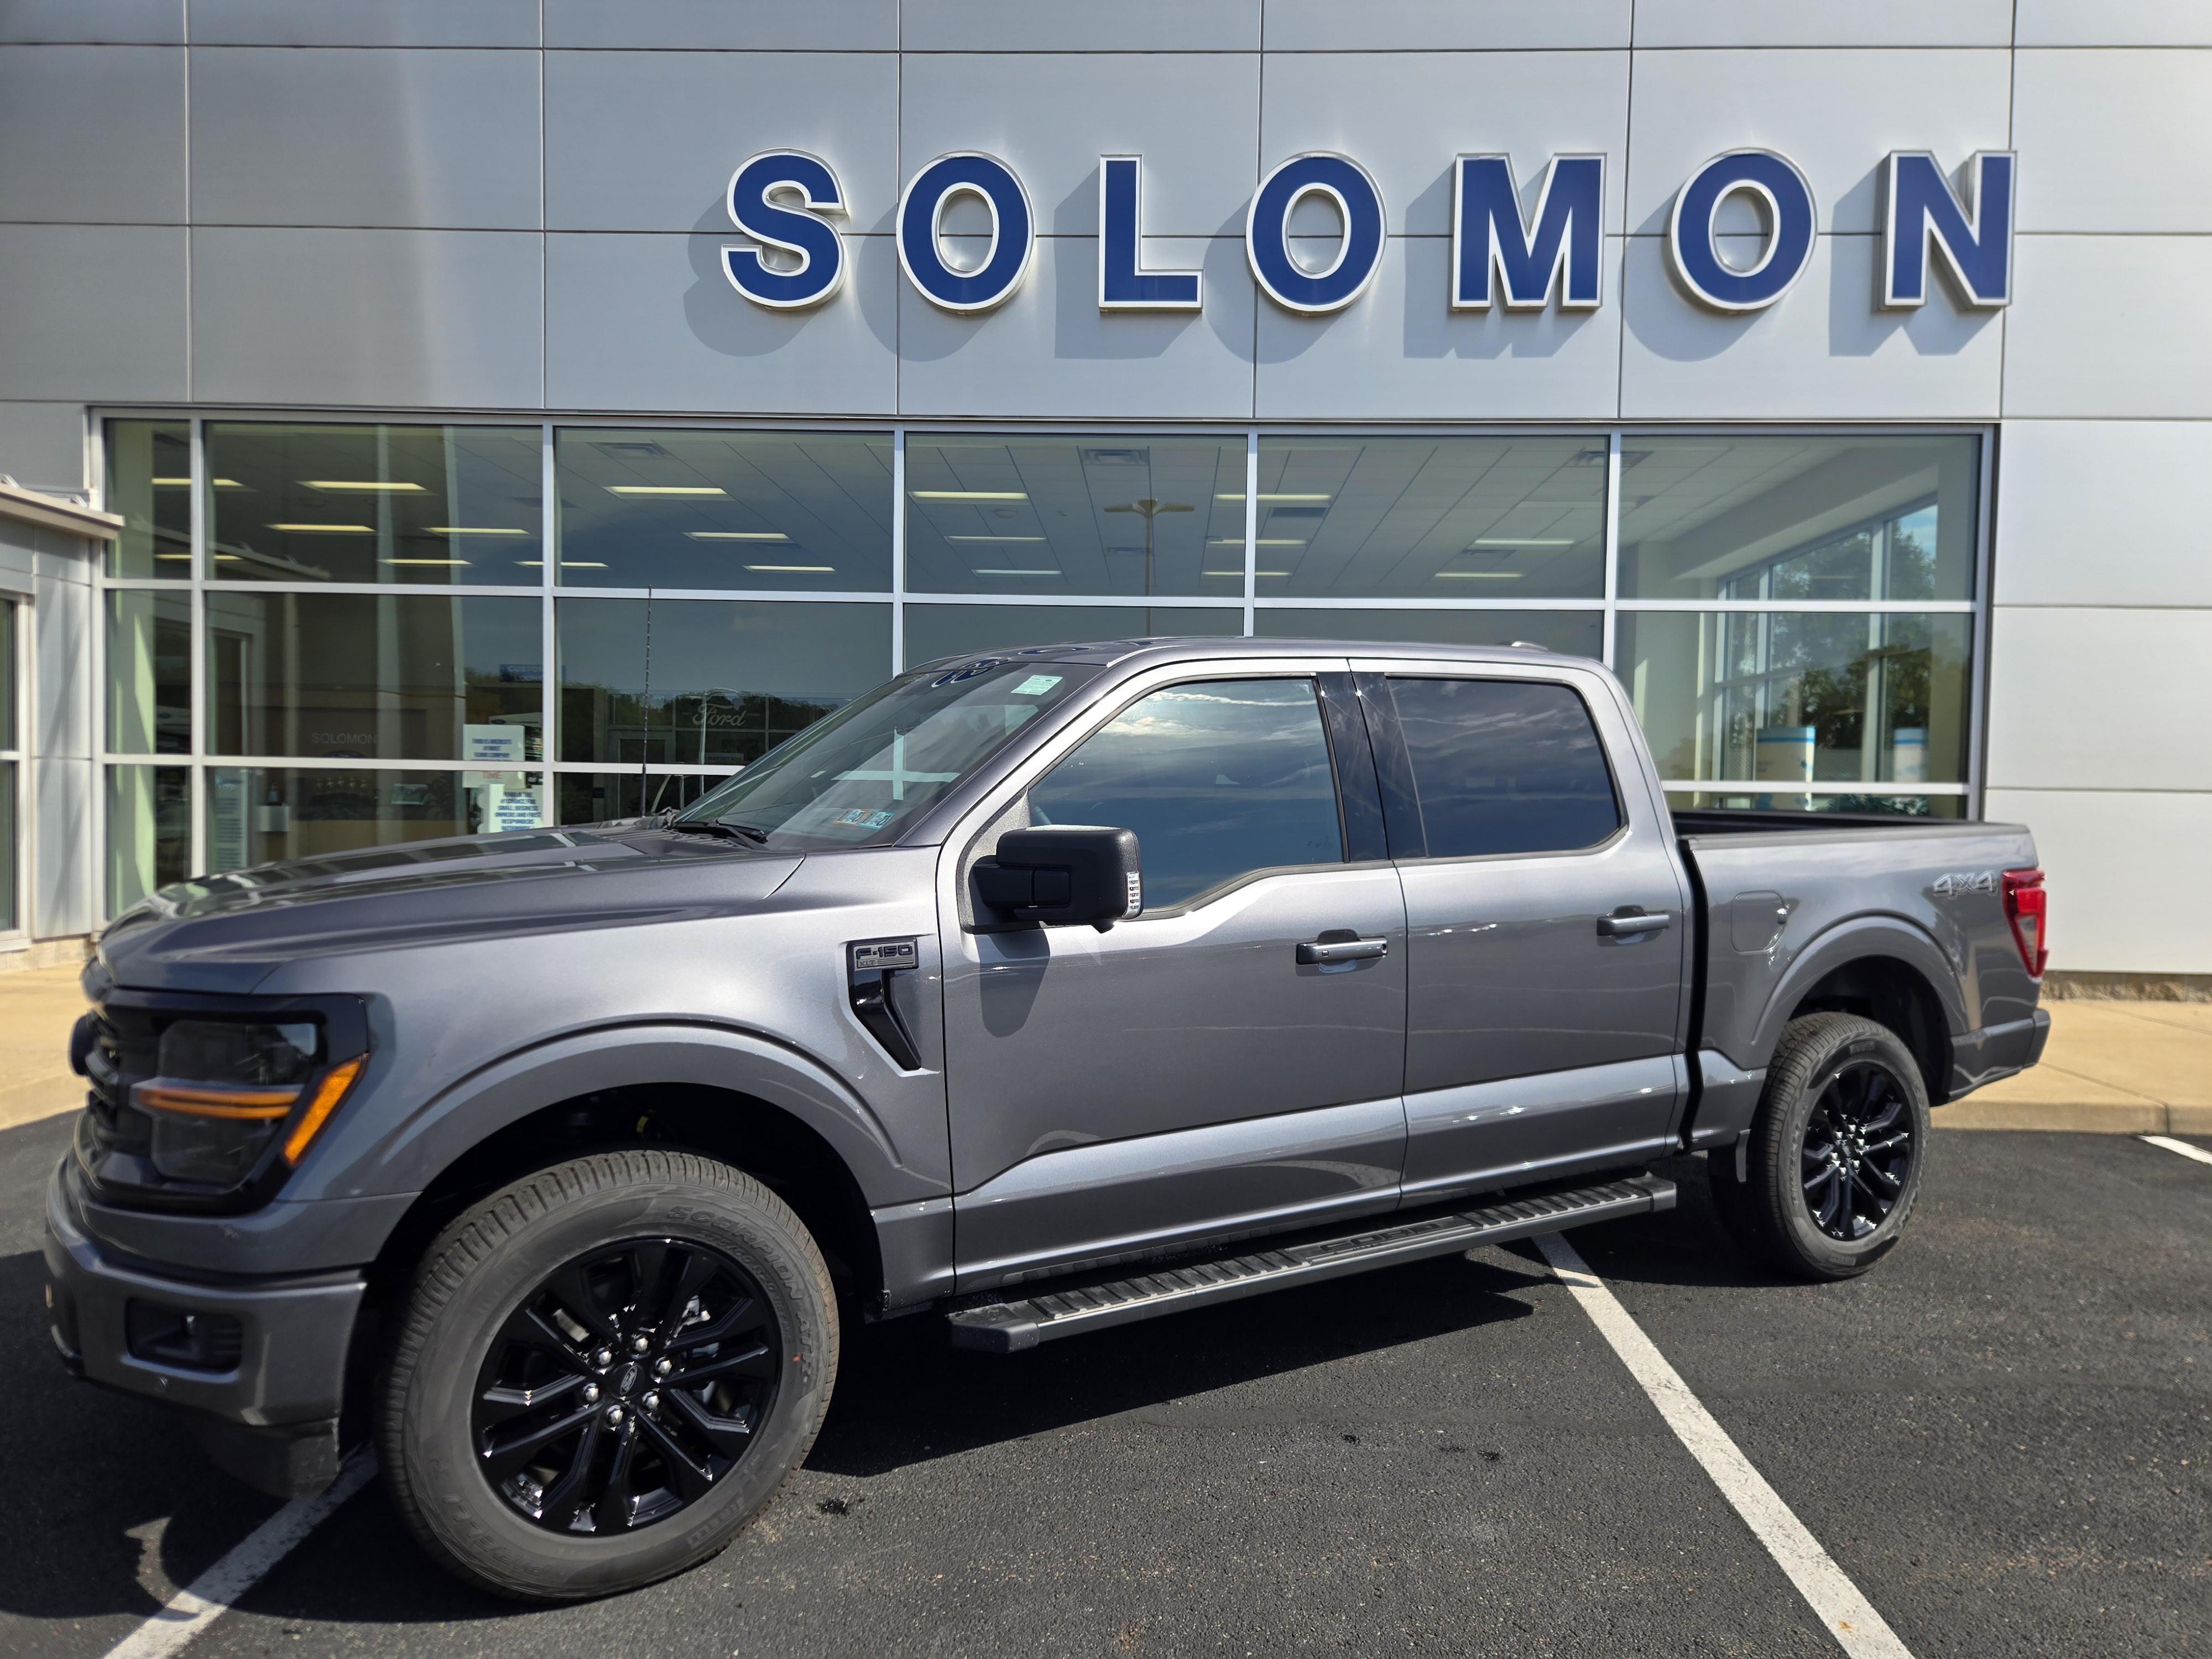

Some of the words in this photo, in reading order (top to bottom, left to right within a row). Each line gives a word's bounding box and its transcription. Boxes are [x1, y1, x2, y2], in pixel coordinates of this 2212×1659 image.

[721, 147, 2018, 315] SOLOMON
[692, 703, 747, 726] Ford
[311, 733, 378, 744] SOLOMON
[856, 945, 913, 959] F-150
[666, 1205, 804, 1300] SCORPION
[796, 1312, 815, 1376] ATR
